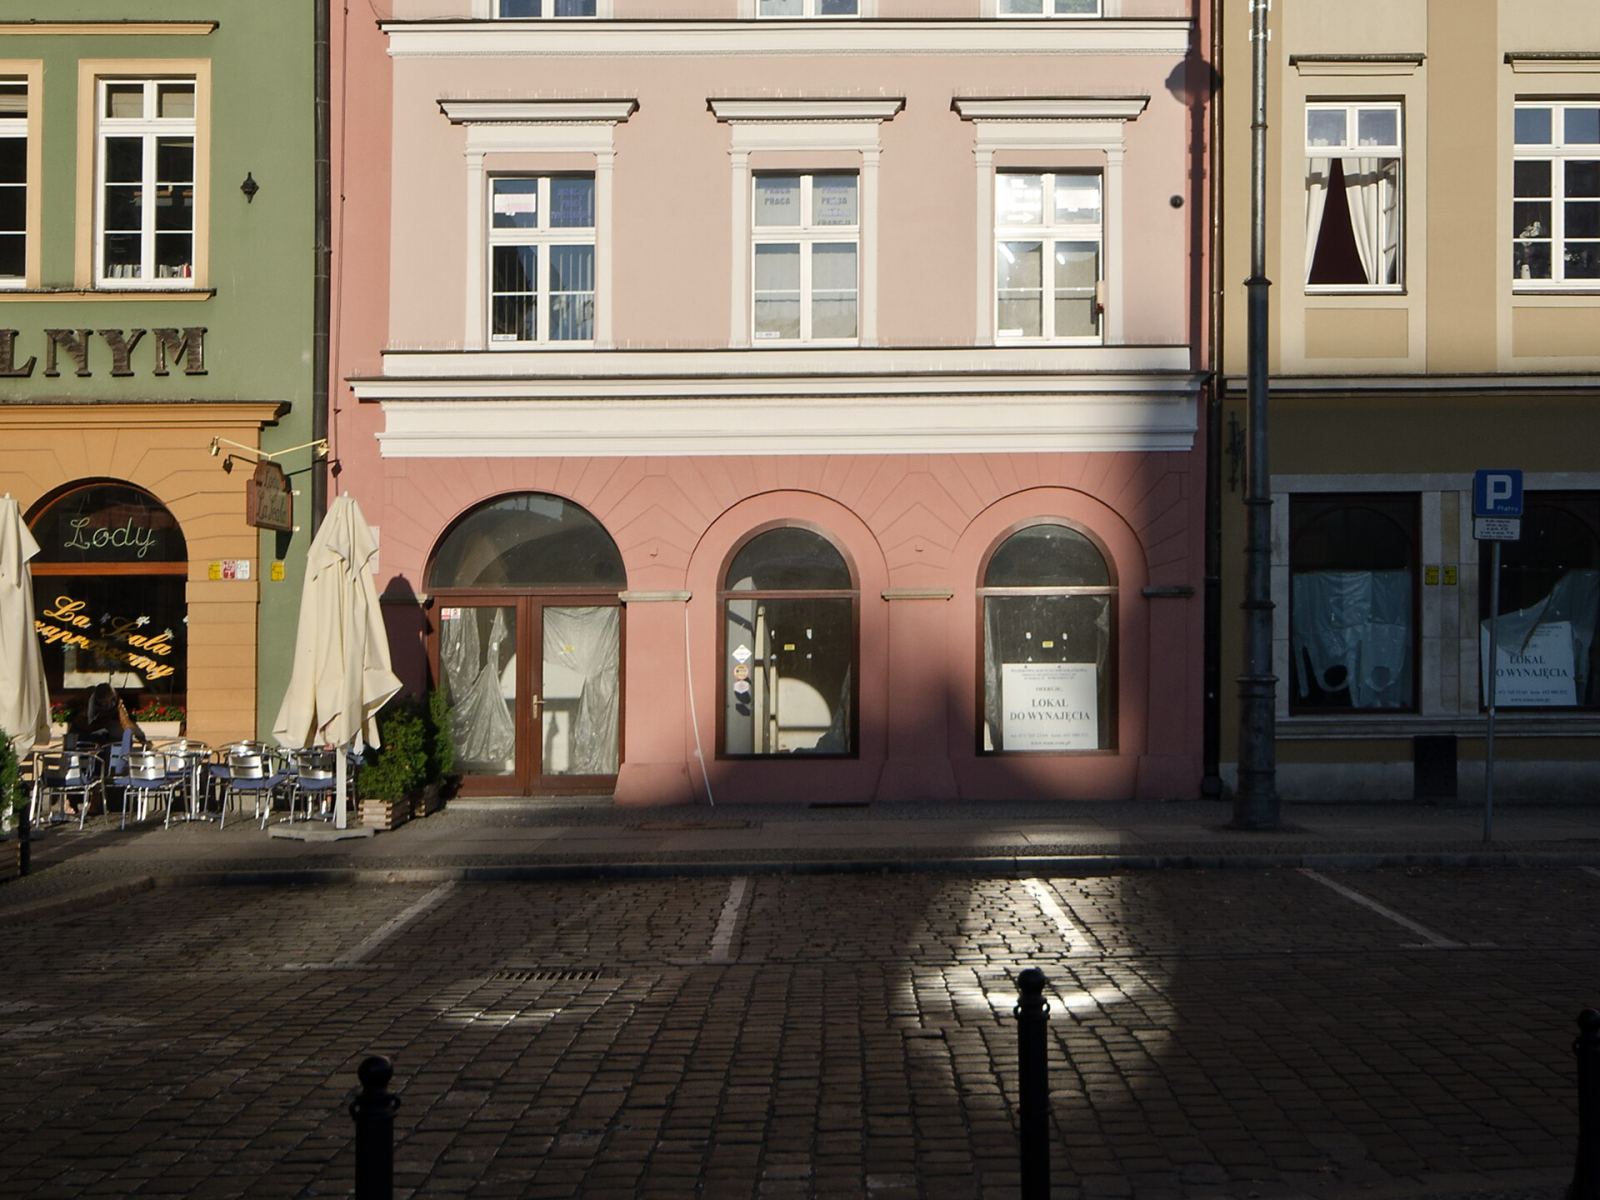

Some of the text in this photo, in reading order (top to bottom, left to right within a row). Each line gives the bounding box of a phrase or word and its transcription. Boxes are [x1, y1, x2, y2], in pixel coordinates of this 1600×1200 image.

[1486, 474, 1512, 510] P
[64, 518, 156, 559] Lody
[43, 595, 92, 629] La
[1010, 711, 1091, 723] DO WYNAJĘCIA
[1032, 698, 1069, 708] LOKAL
